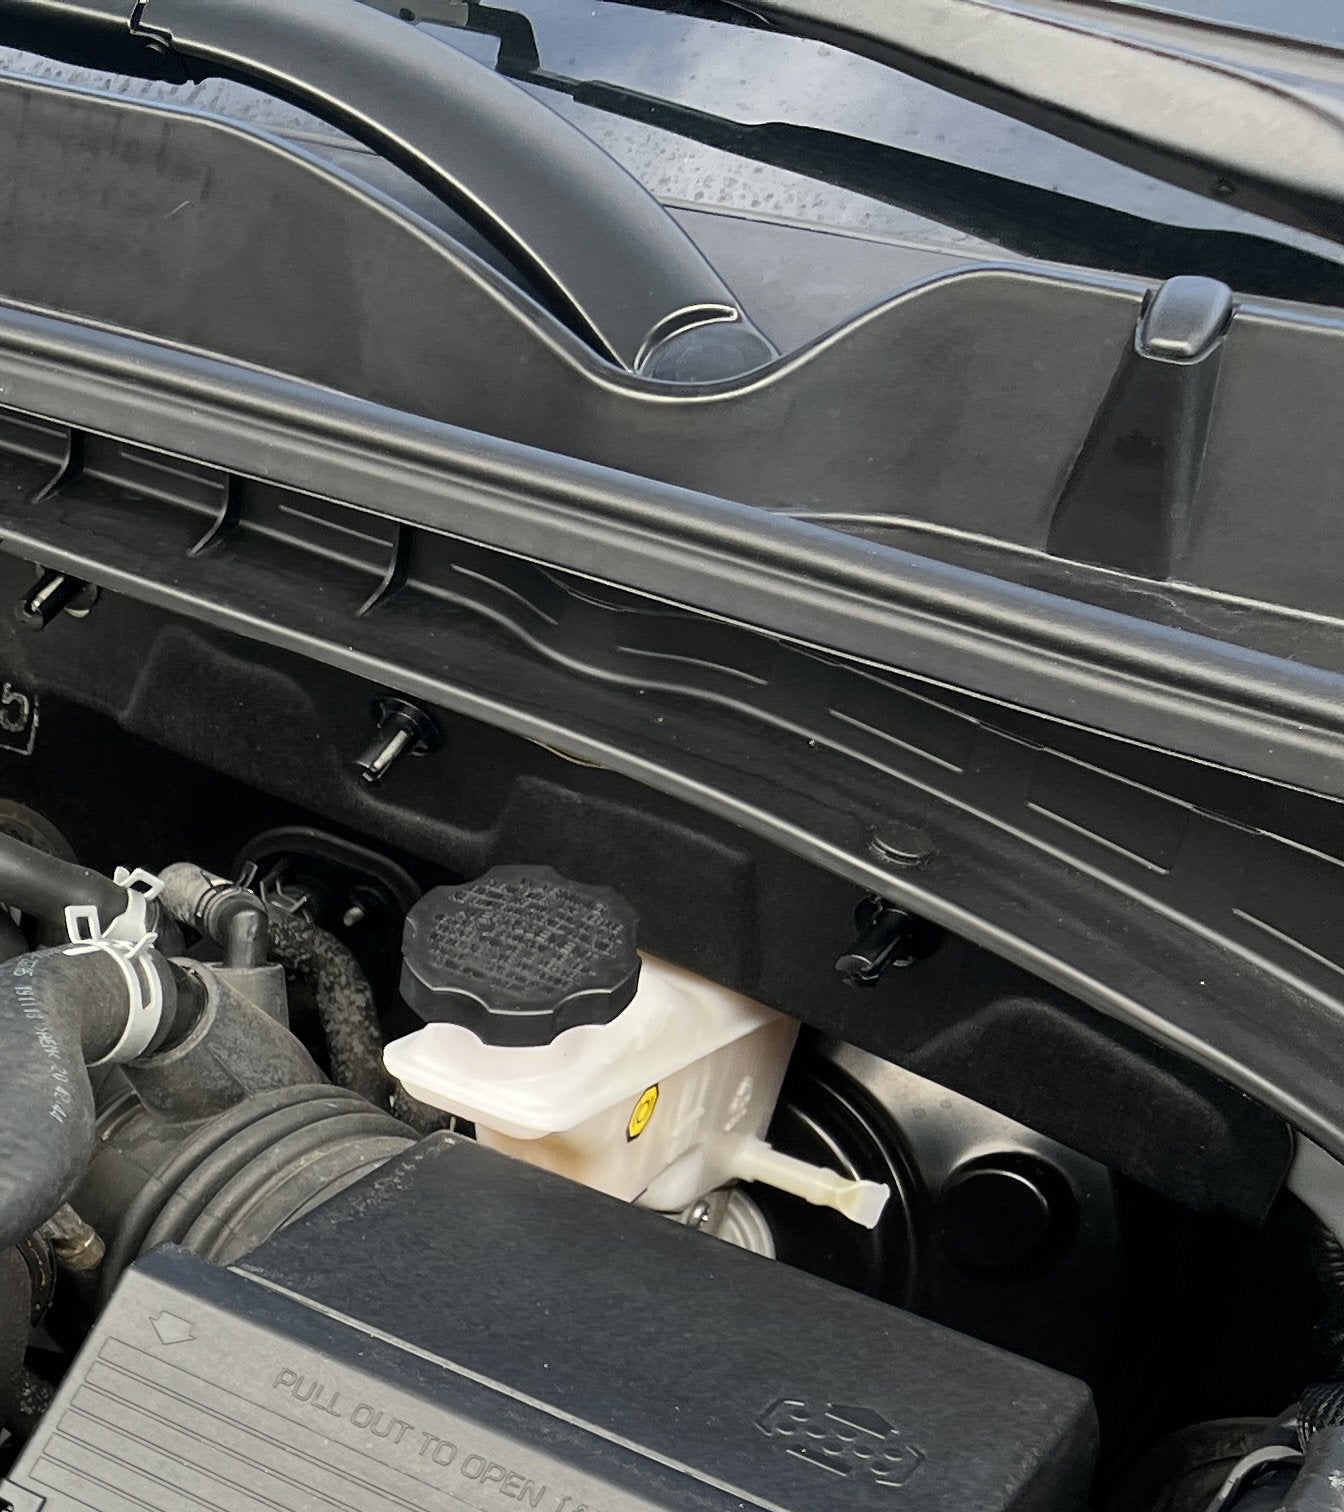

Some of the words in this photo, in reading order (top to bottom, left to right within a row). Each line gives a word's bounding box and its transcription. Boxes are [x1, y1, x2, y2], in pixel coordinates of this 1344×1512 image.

[271, 1366, 341, 1419] PULL
[350, 1402, 414, 1446] OUT
[418, 1430, 459, 1468] TO
[460, 1453, 548, 1509] OPEN
